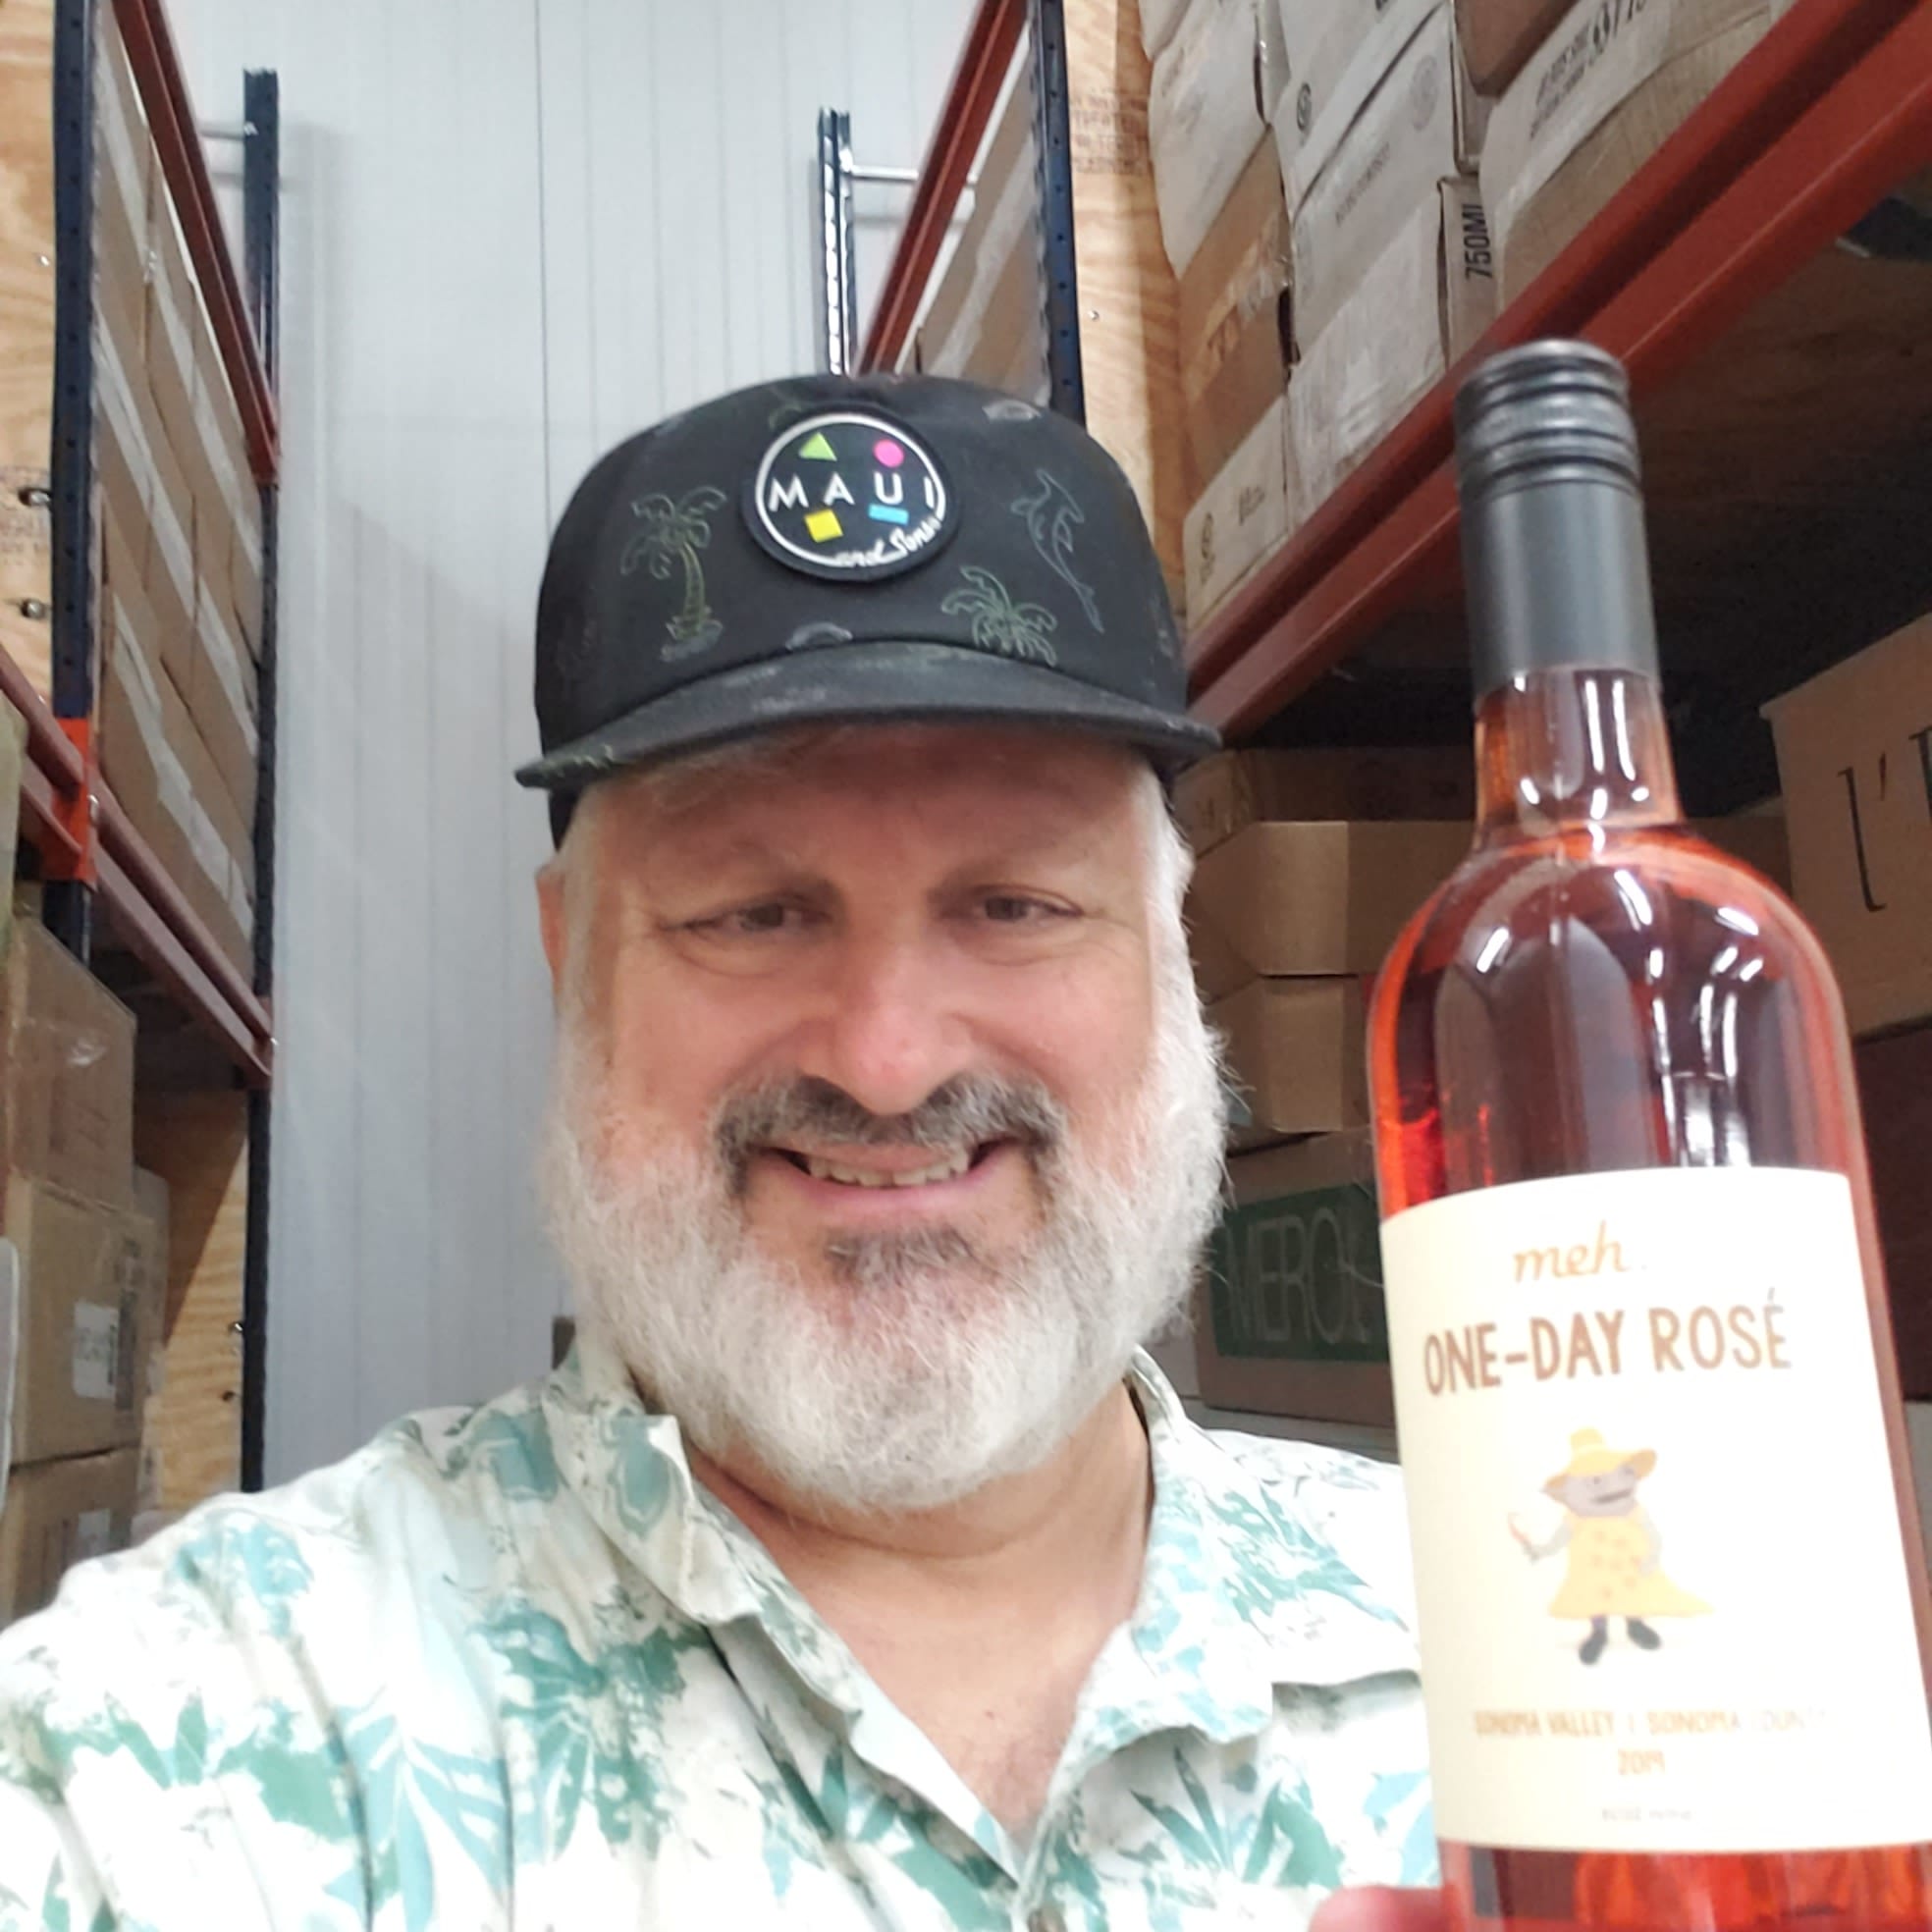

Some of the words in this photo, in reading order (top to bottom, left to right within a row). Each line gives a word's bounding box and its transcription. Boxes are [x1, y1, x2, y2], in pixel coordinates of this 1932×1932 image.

[769, 471, 936, 511] MAUI
[1423, 1309, 1626, 1396] ONE-DAY
[1648, 1287, 1792, 1372] ROSÉ
[1546, 1710, 1614, 1737] VALLEY
[1648, 1709, 1741, 1735] SONOMA
